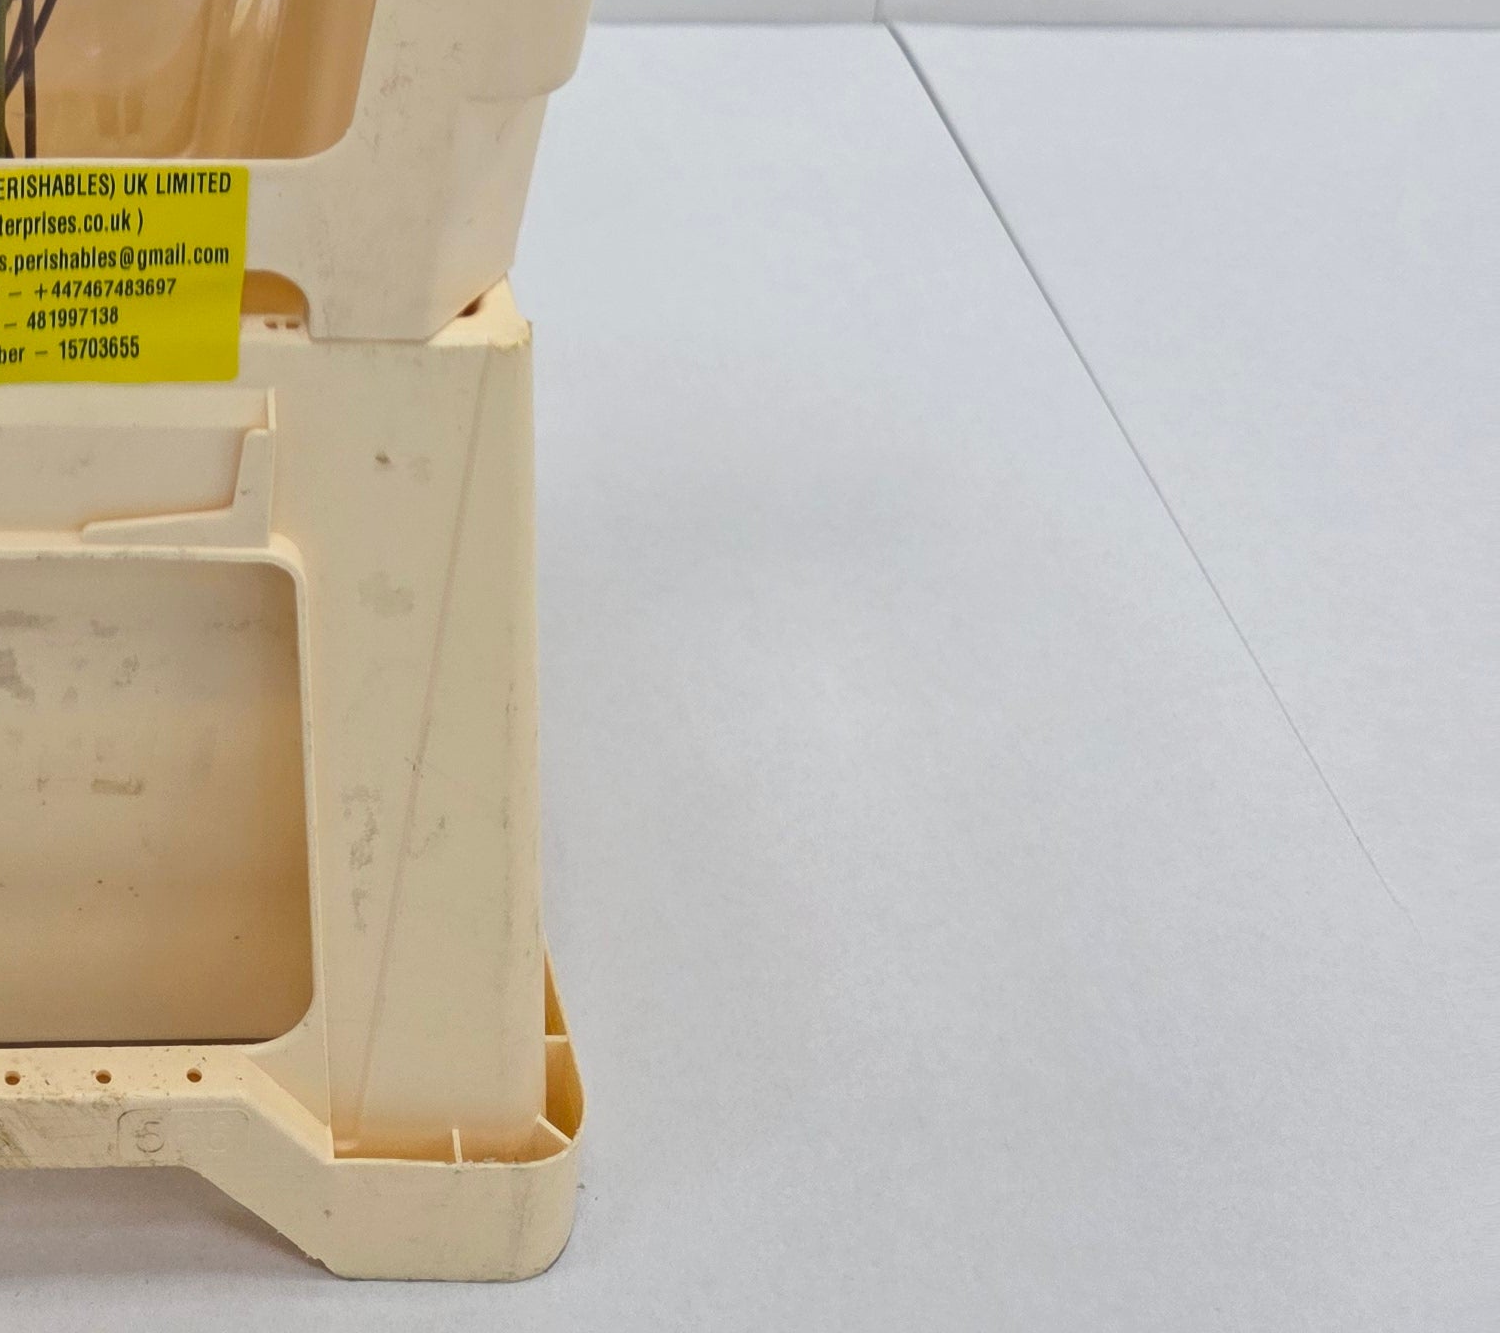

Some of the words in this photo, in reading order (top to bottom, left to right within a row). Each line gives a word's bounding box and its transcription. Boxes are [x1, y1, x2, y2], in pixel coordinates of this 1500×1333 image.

[123, 172, 149, 198] UK
[155, 171, 232, 196] LIMITED
[33, 277, 177, 301] +447467483697
[26, 305, 119, 332] 481997138
[58, 334, 140, 362] 15703655
